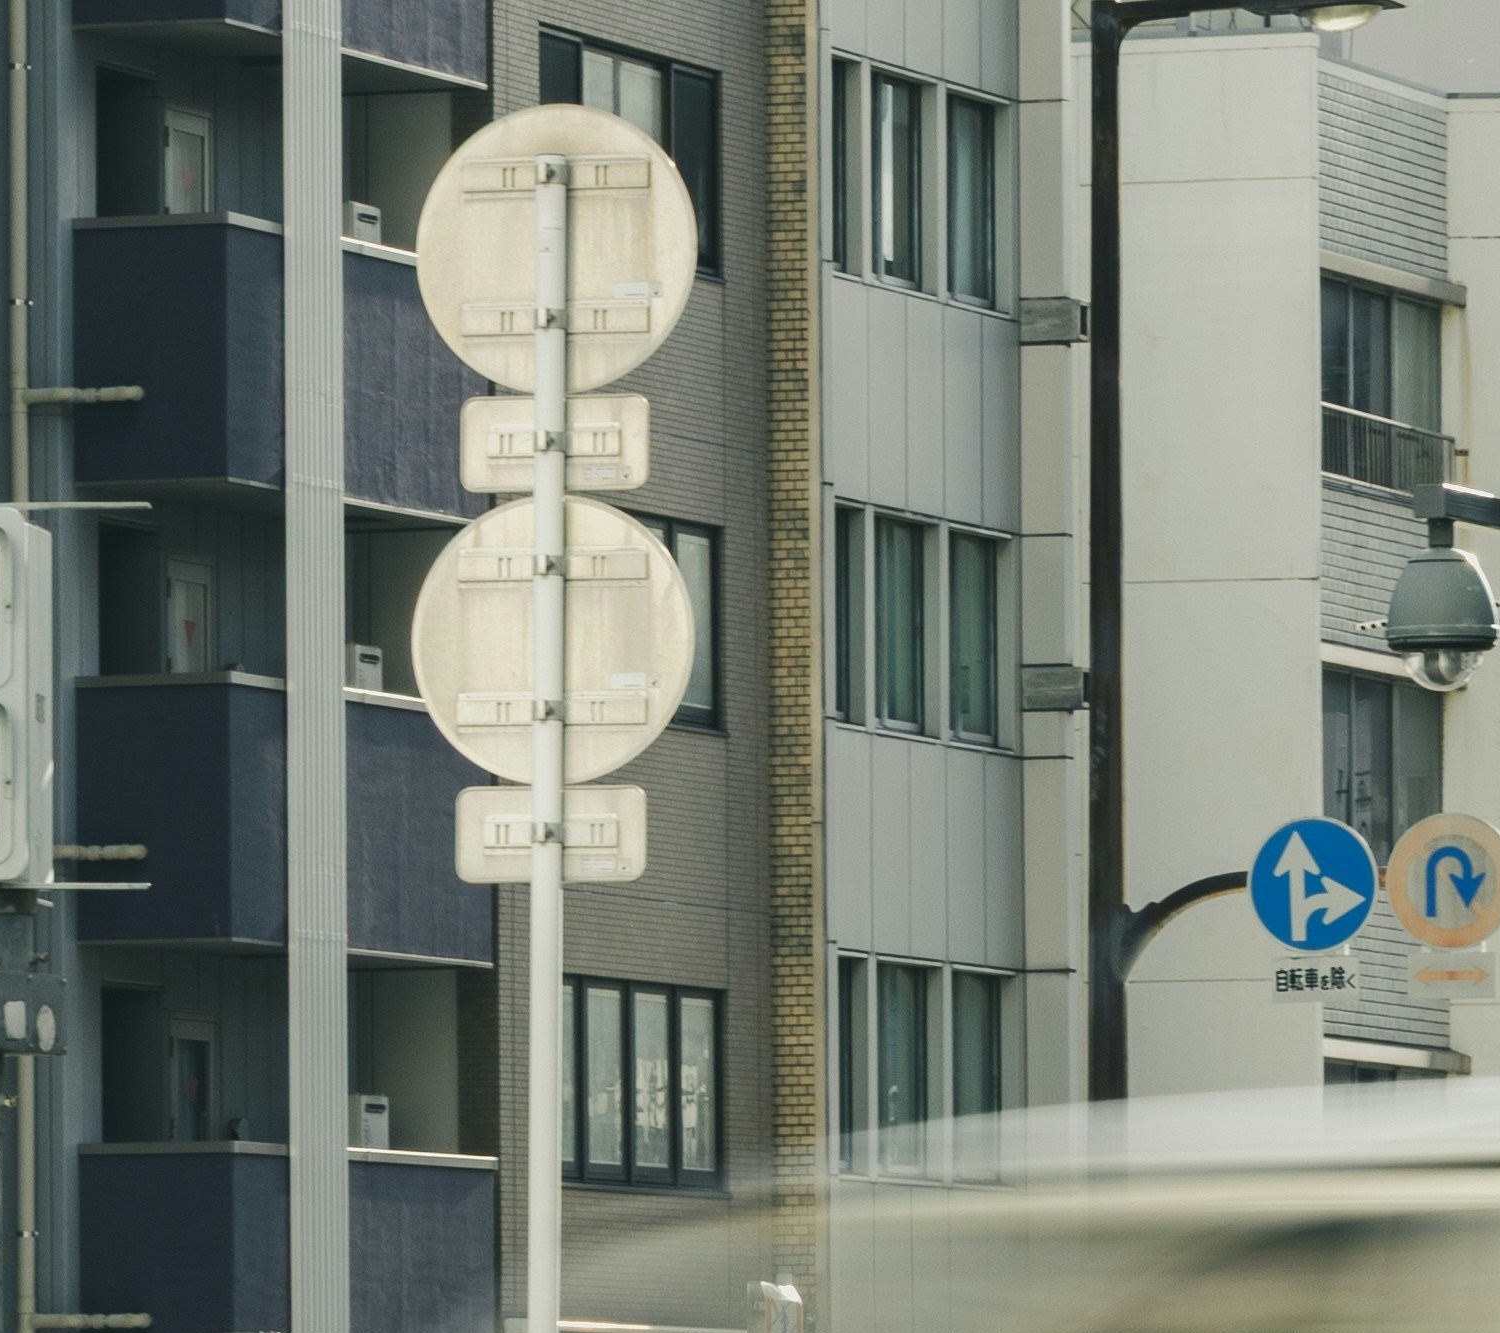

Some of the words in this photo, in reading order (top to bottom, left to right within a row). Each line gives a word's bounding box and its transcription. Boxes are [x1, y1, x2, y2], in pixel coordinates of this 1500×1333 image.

[1276, 967, 1356, 992] 自転車を除く
